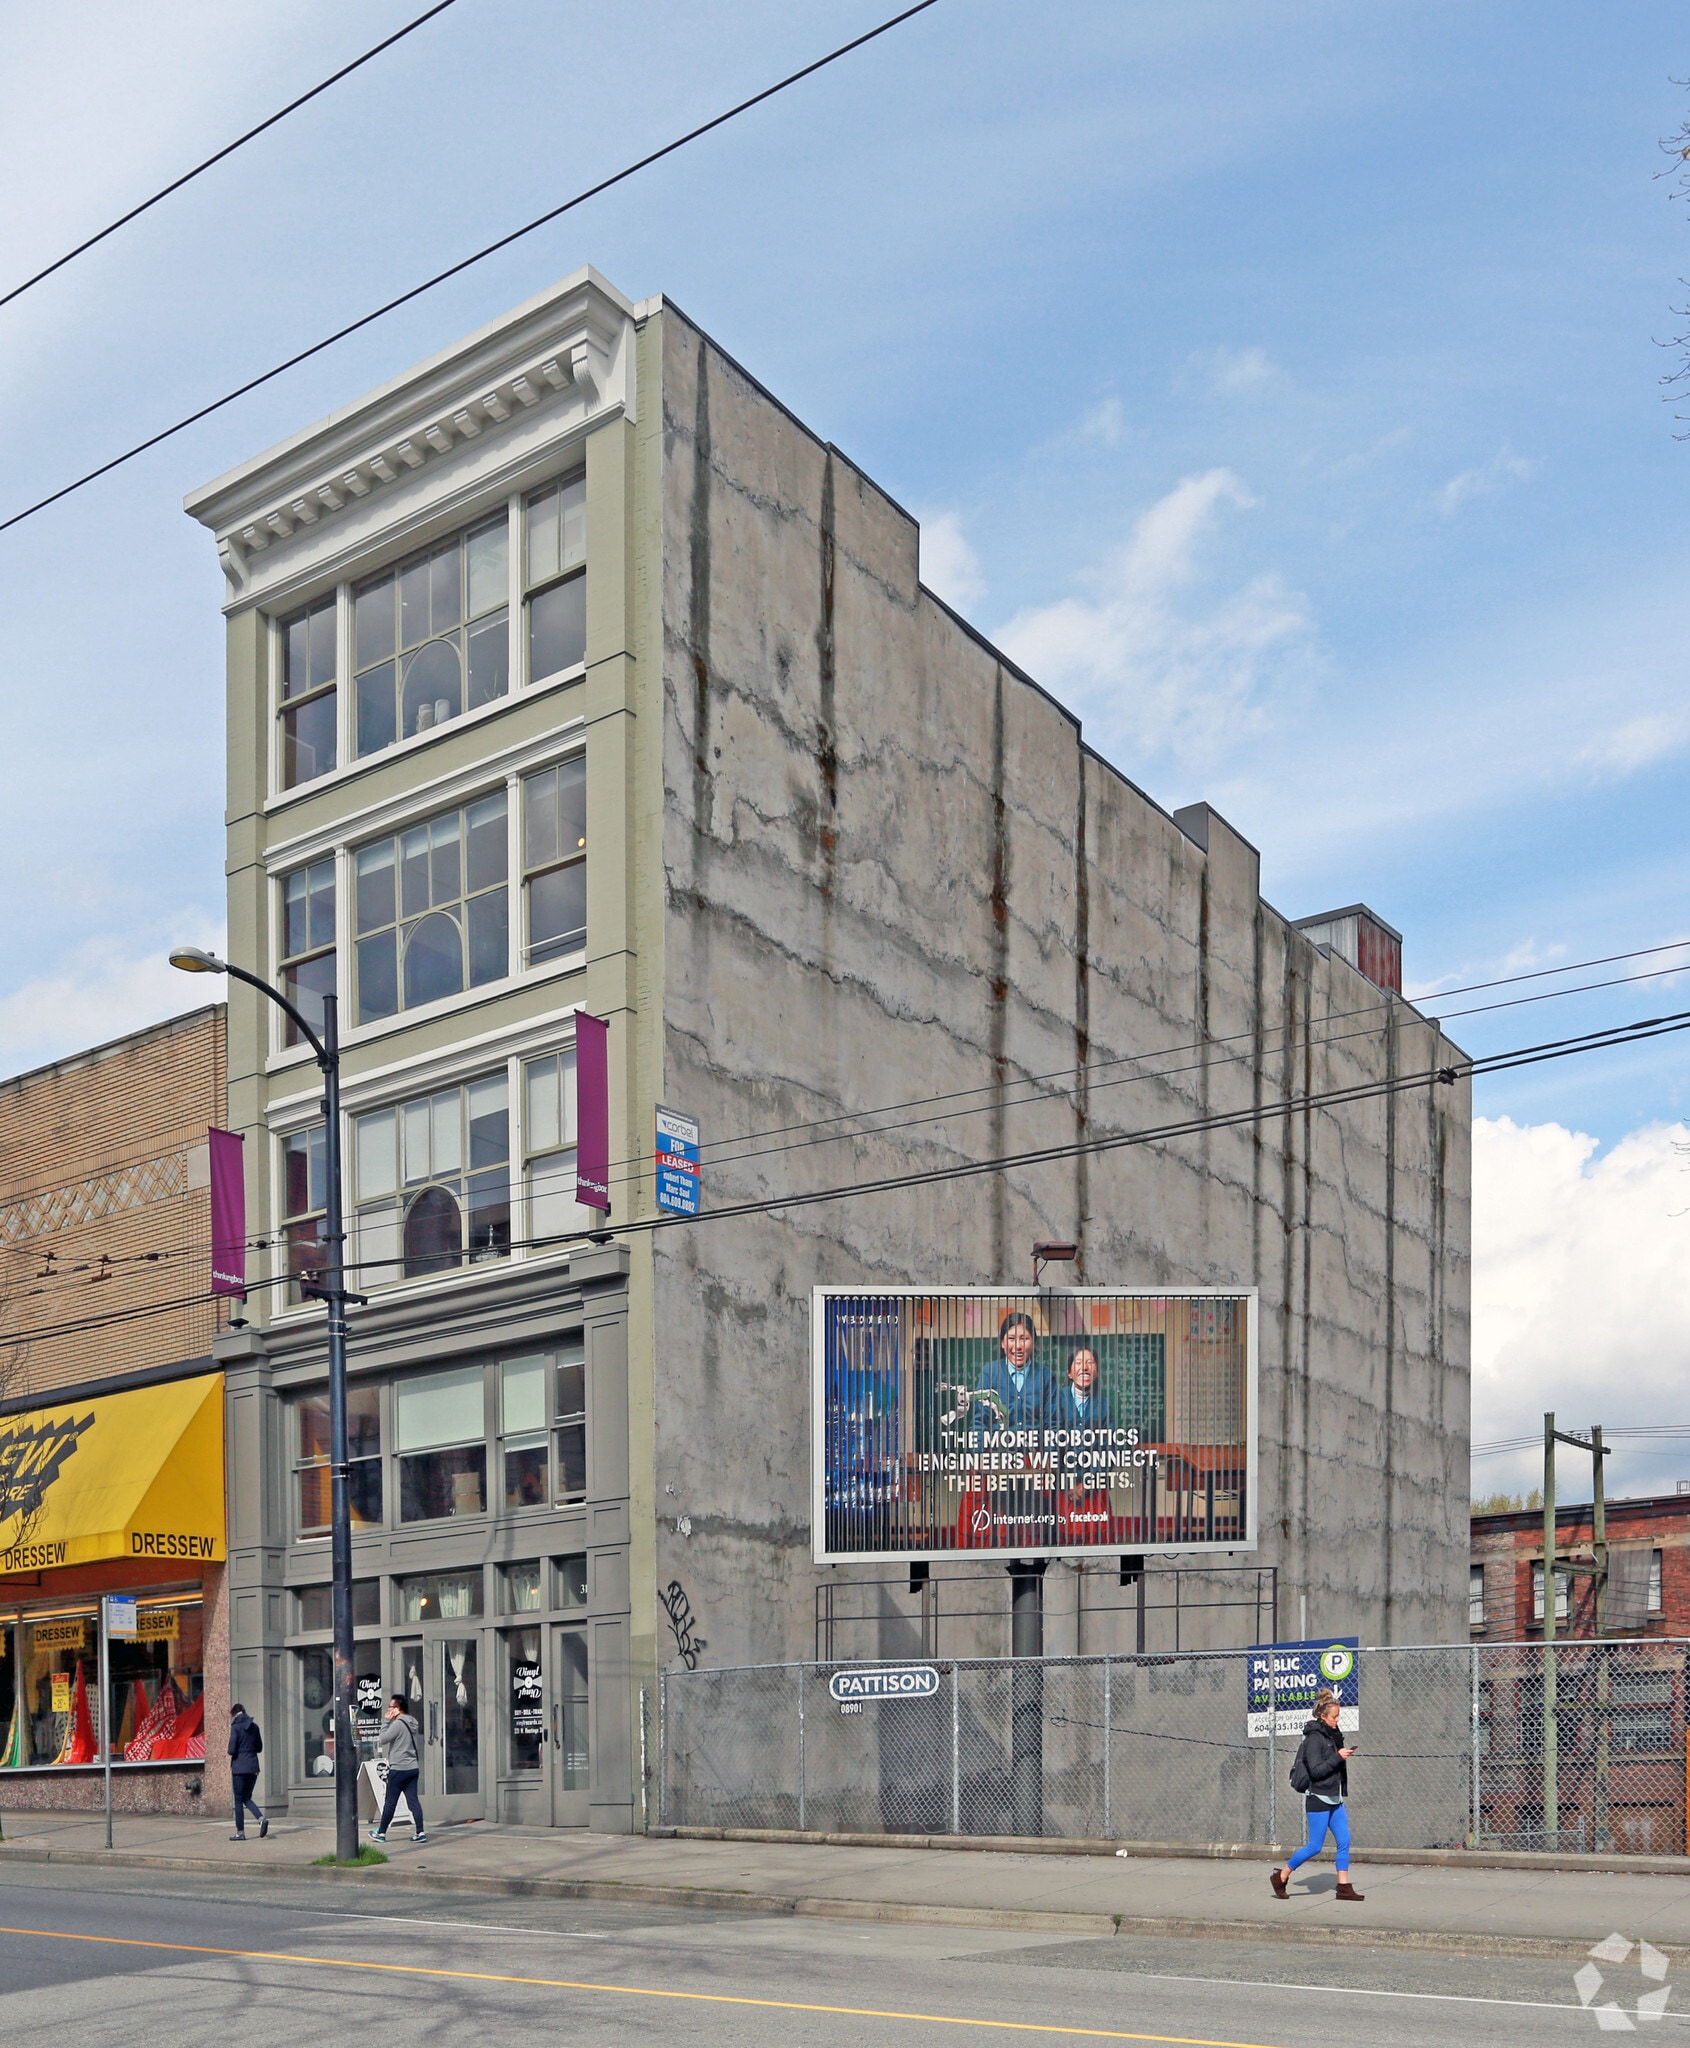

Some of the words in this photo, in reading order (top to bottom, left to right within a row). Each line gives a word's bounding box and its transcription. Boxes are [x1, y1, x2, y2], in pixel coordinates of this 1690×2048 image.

[670, 1138, 685, 1156] FOR
[662, 1154, 694, 1173] LEASED
[941, 1430, 979, 1449] THE
[983, 1430, 1039, 1448] MORE
[1043, 1428, 1139, 1447] ROBOTICS
[918, 1452, 1025, 1471] ENGINEERS
[1028, 1451, 1058, 1469] WE
[1063, 1449, 1160, 1470] CONNECT,
[944, 1474, 982, 1492] THE
[986, 1472, 1056, 1491] BETTER
[1060, 1472, 1078, 1490] IT
[1082, 1471, 1136, 1490] GETS.
[993, 1513, 1055, 1526] internet.org
[1058, 1514, 1067, 1525] by
[1070, 1511, 1109, 1523] facebook
[132, 1532, 215, 1558] DRESSEW
[5, 1541, 67, 1570] DRESSEW
[136, 1615, 174, 1631] ESSEW
[36, 1626, 79, 1642] DRESSEW
[516, 1665, 540, 1678] Vinyl
[1253, 1657, 1300, 1674] PUBLIC
[359, 1678, 380, 1690] Vinyl
[839, 1673, 931, 1694] PATTISON
[1254, 1673, 1318, 1691] PARKING
[1254, 1690, 1316, 1704] AVILABLE
[840, 1703, 862, 1714] 08901
